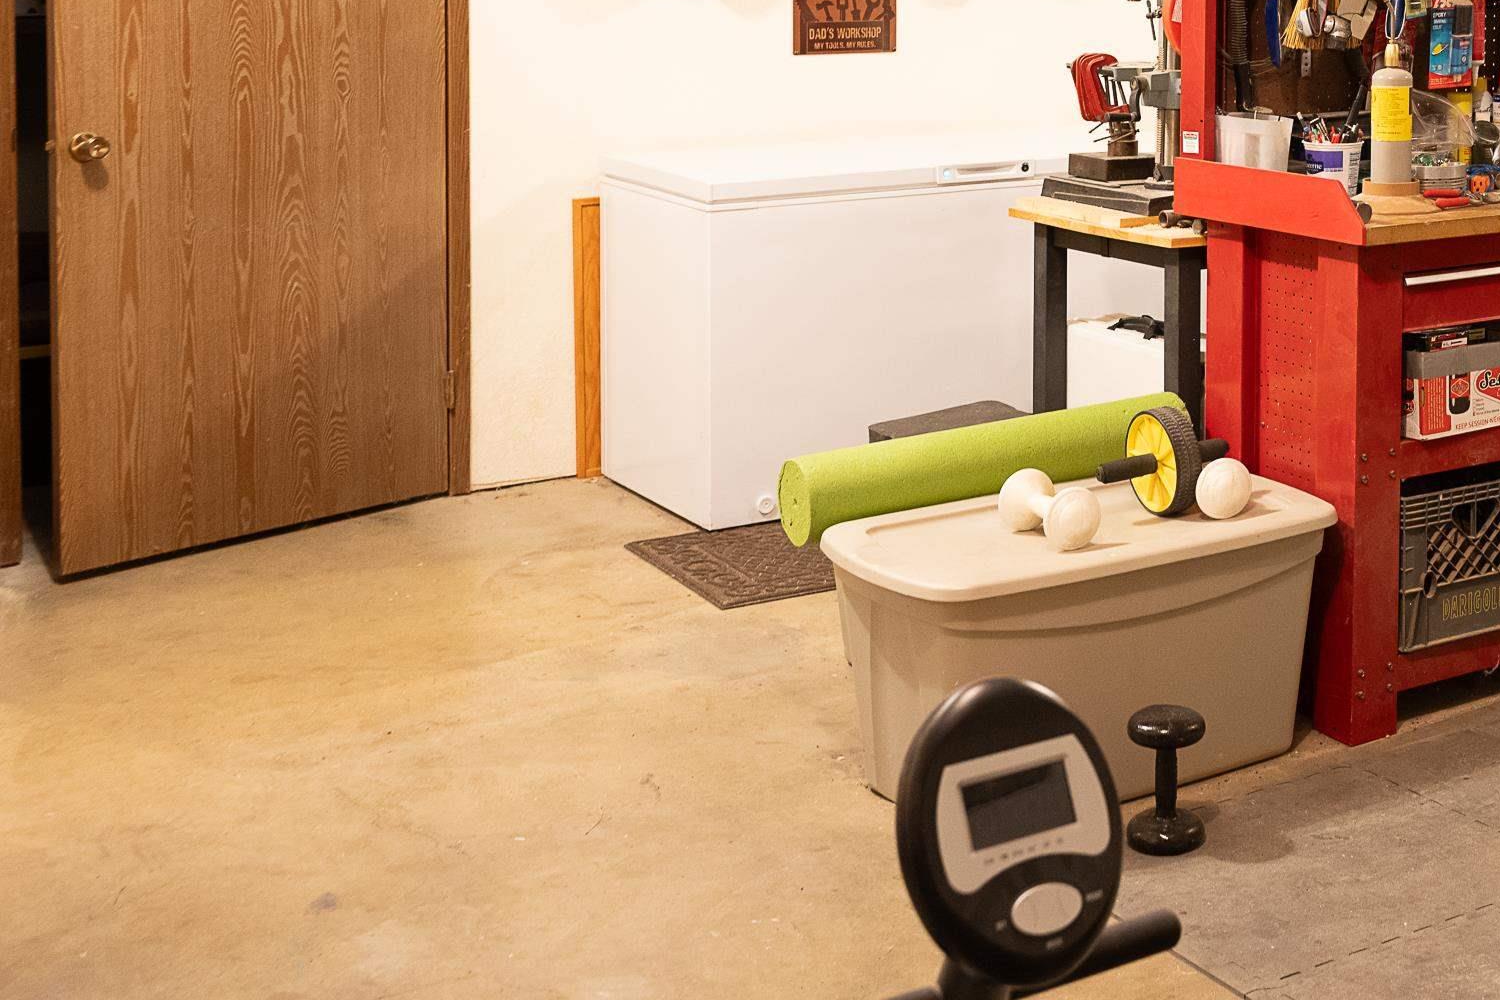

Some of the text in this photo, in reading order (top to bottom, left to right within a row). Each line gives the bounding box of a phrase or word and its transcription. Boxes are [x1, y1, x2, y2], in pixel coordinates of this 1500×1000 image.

[809, 26, 882, 40] DAD'S WORKSHOP
[1469, 417, 1489, 428] SESSION
